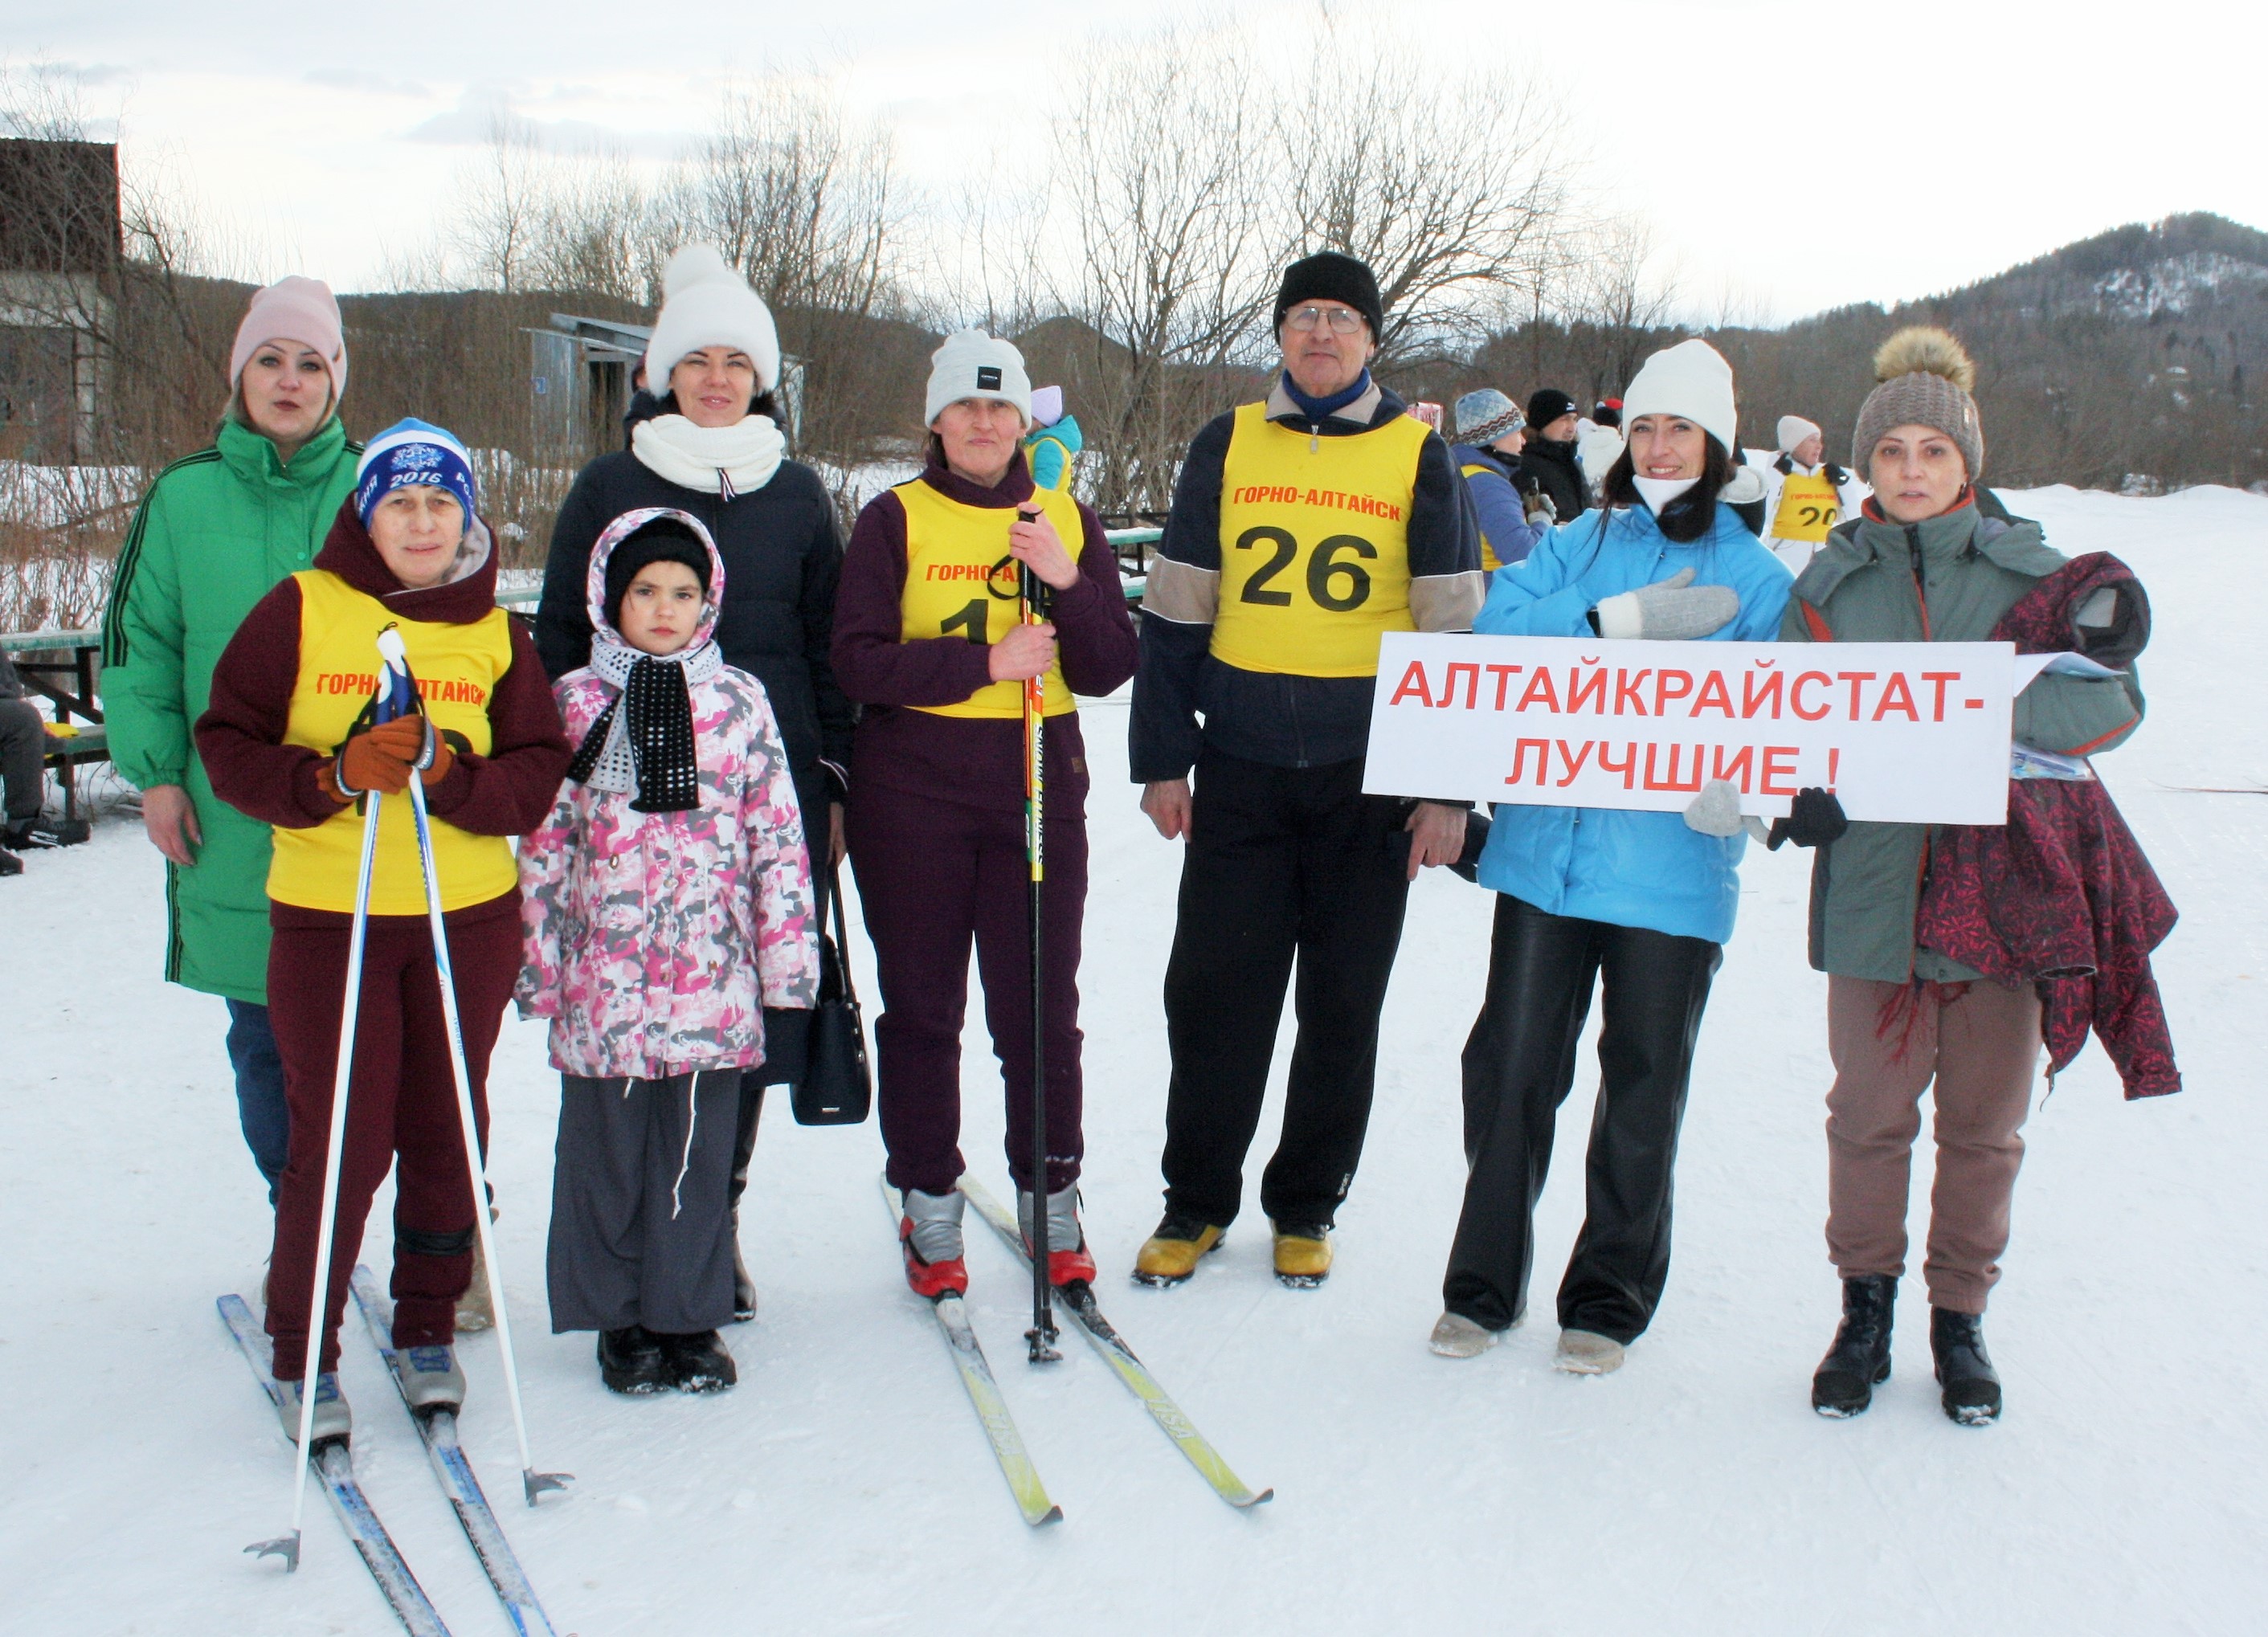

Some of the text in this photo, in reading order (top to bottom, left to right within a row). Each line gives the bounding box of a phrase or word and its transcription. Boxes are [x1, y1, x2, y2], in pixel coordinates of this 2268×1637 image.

[390, 471, 442, 488] 2016
[1234, 486, 1400, 521] ГОРНО-АЛТАЙСК
[1236, 526, 1377, 612] 26
[1389, 655, 1984, 722] АЛТАЙКРАЙСТАТ-
[1505, 737, 1800, 795] ЛУЧШИЕ
